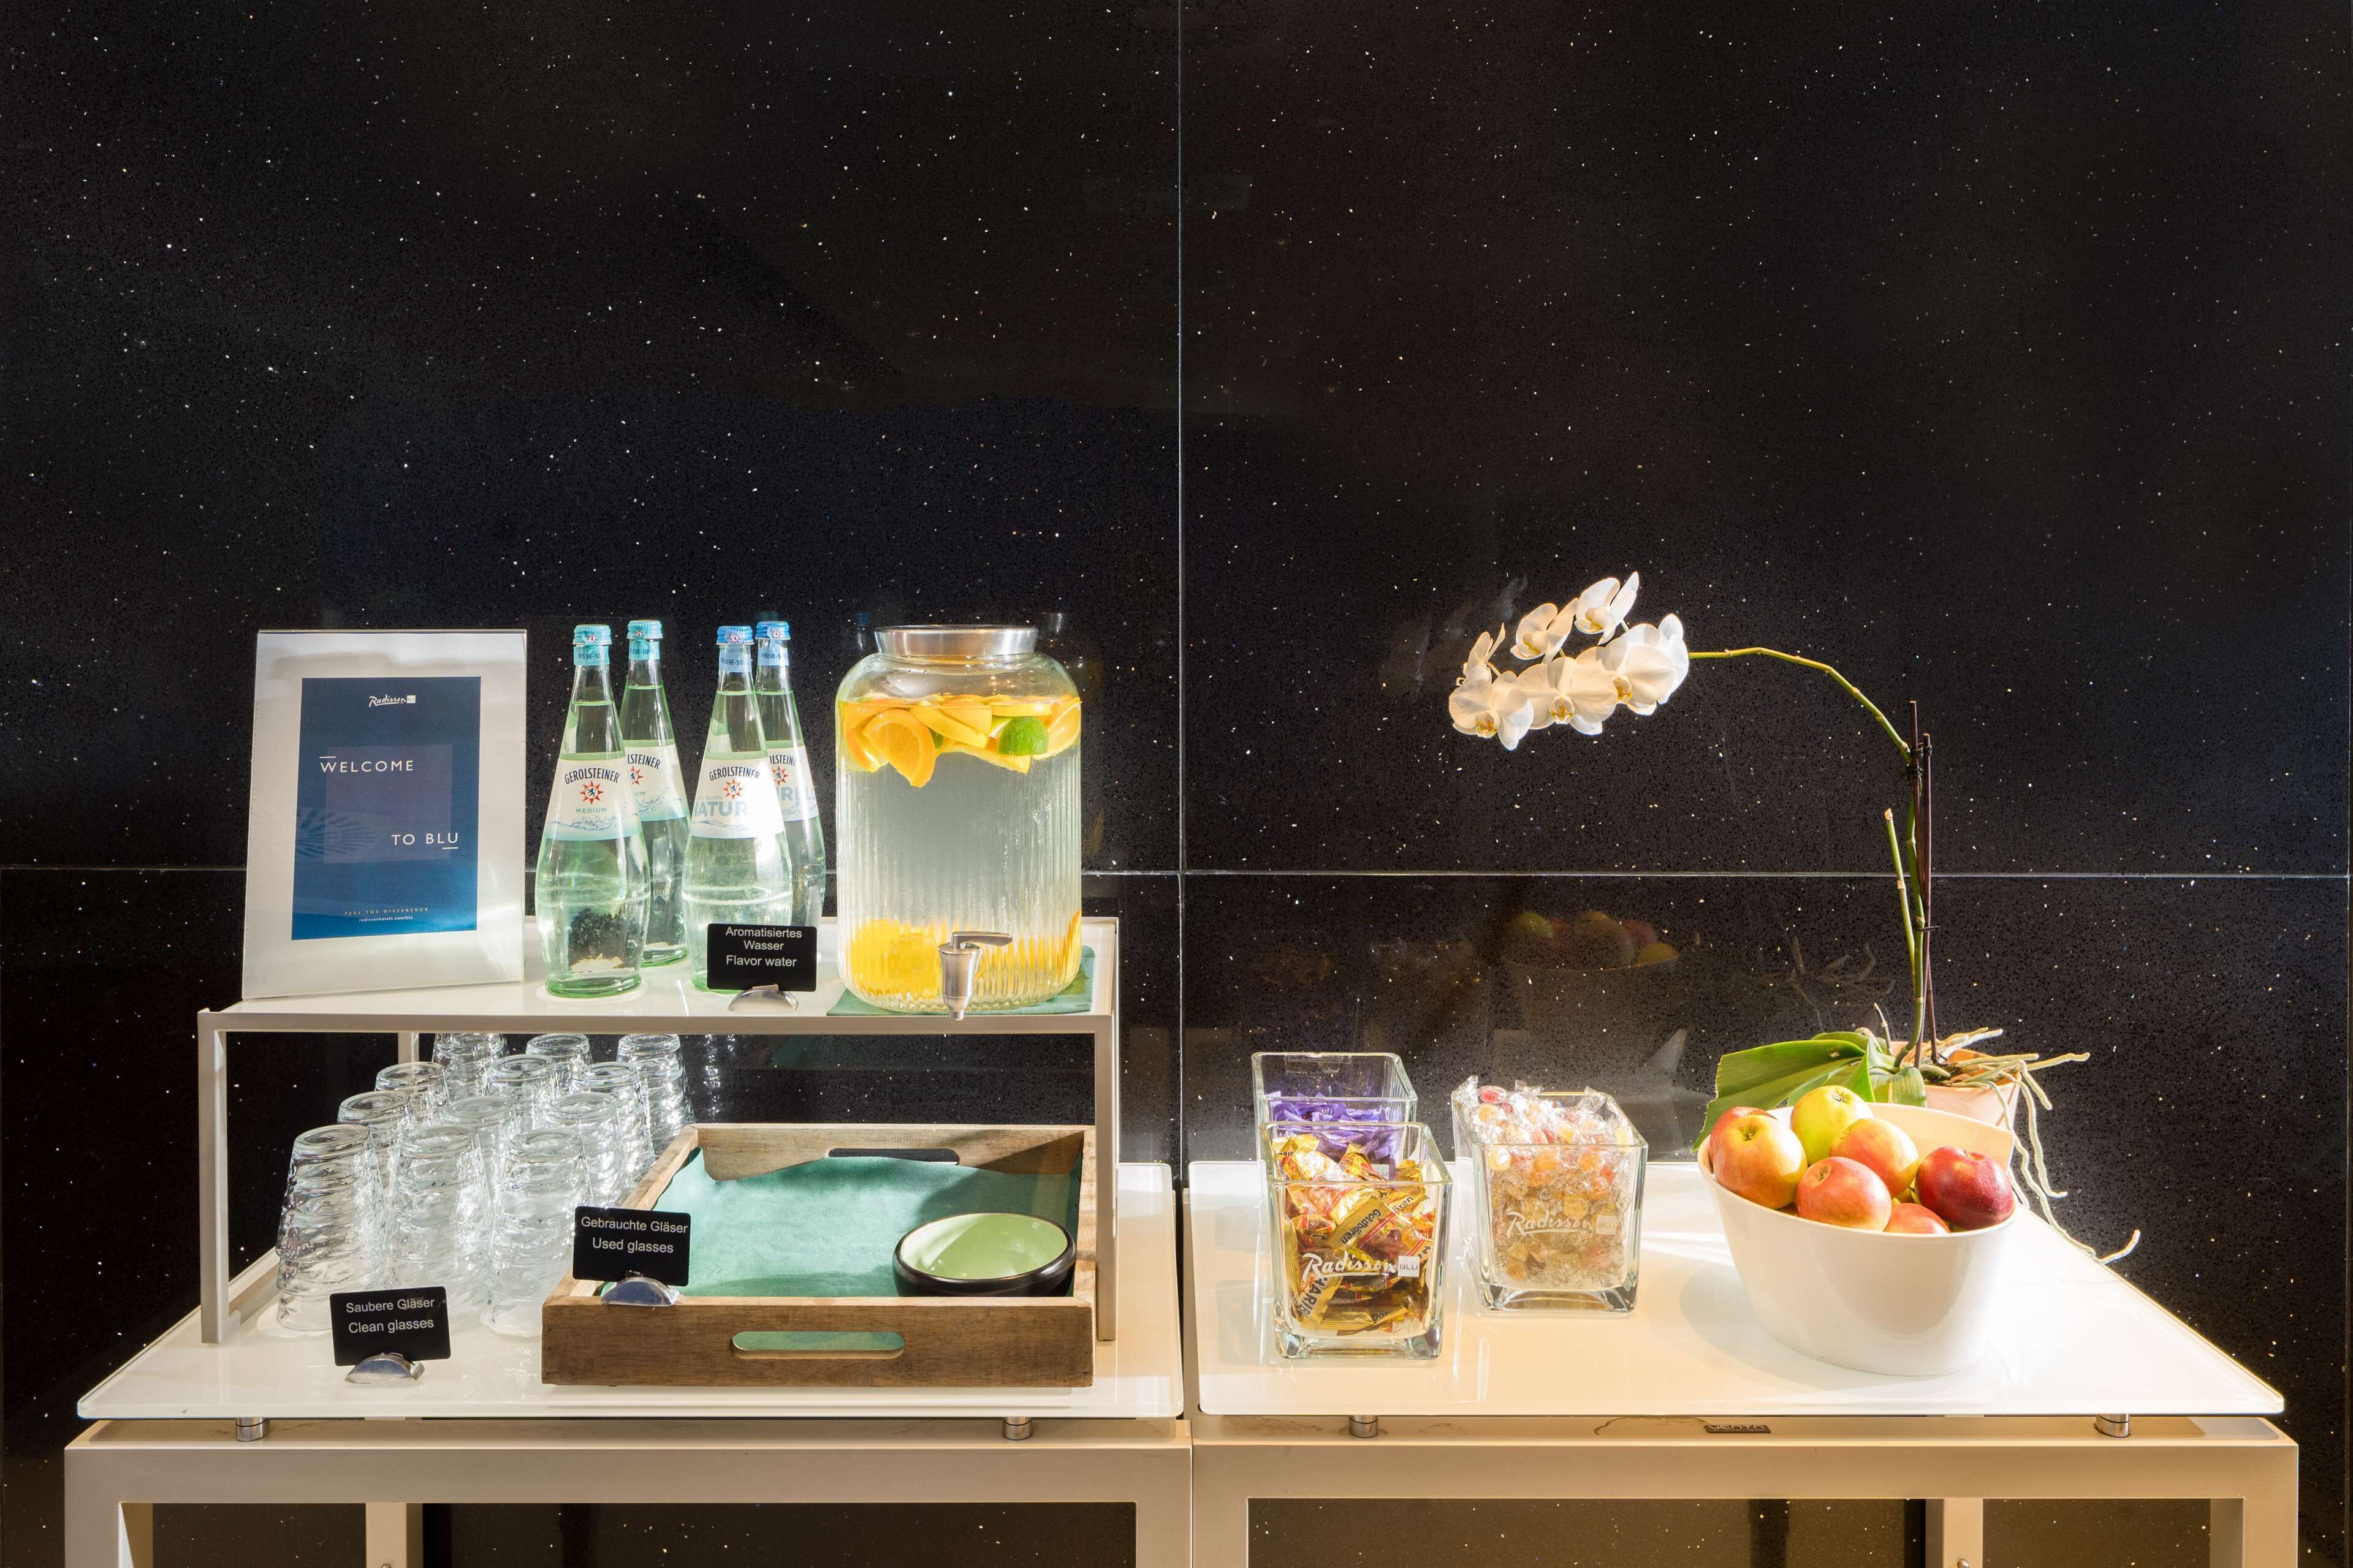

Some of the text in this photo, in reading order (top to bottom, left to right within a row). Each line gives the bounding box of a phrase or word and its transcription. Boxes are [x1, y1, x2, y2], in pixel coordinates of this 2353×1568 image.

[368, 694, 406, 708] Radisson
[319, 760, 414, 773] WELCOME
[627, 754, 661, 769] LSTEINER
[564, 767, 620, 784] GEROLSTEINER
[709, 766, 760, 781] GEROLSTEINER
[693, 800, 749, 817] NATUR
[391, 832, 458, 846] TO BLU
[725, 926, 802, 939] Aromatisiertes
[743, 940, 785, 950] Wasser
[726, 955, 797, 967] Flavor water
[581, 1216, 688, 1233] Gebrauchte Gläser
[1340, 1208, 1382, 1244] Goldbären
[1506, 1208, 1594, 1239] Radisson
[593, 1237, 674, 1254] Used glasses
[1302, 1250, 1399, 1282] Radisson
[346, 1298, 435, 1313] Saubere Gläser
[348, 1319, 435, 1333] Clean glasses
